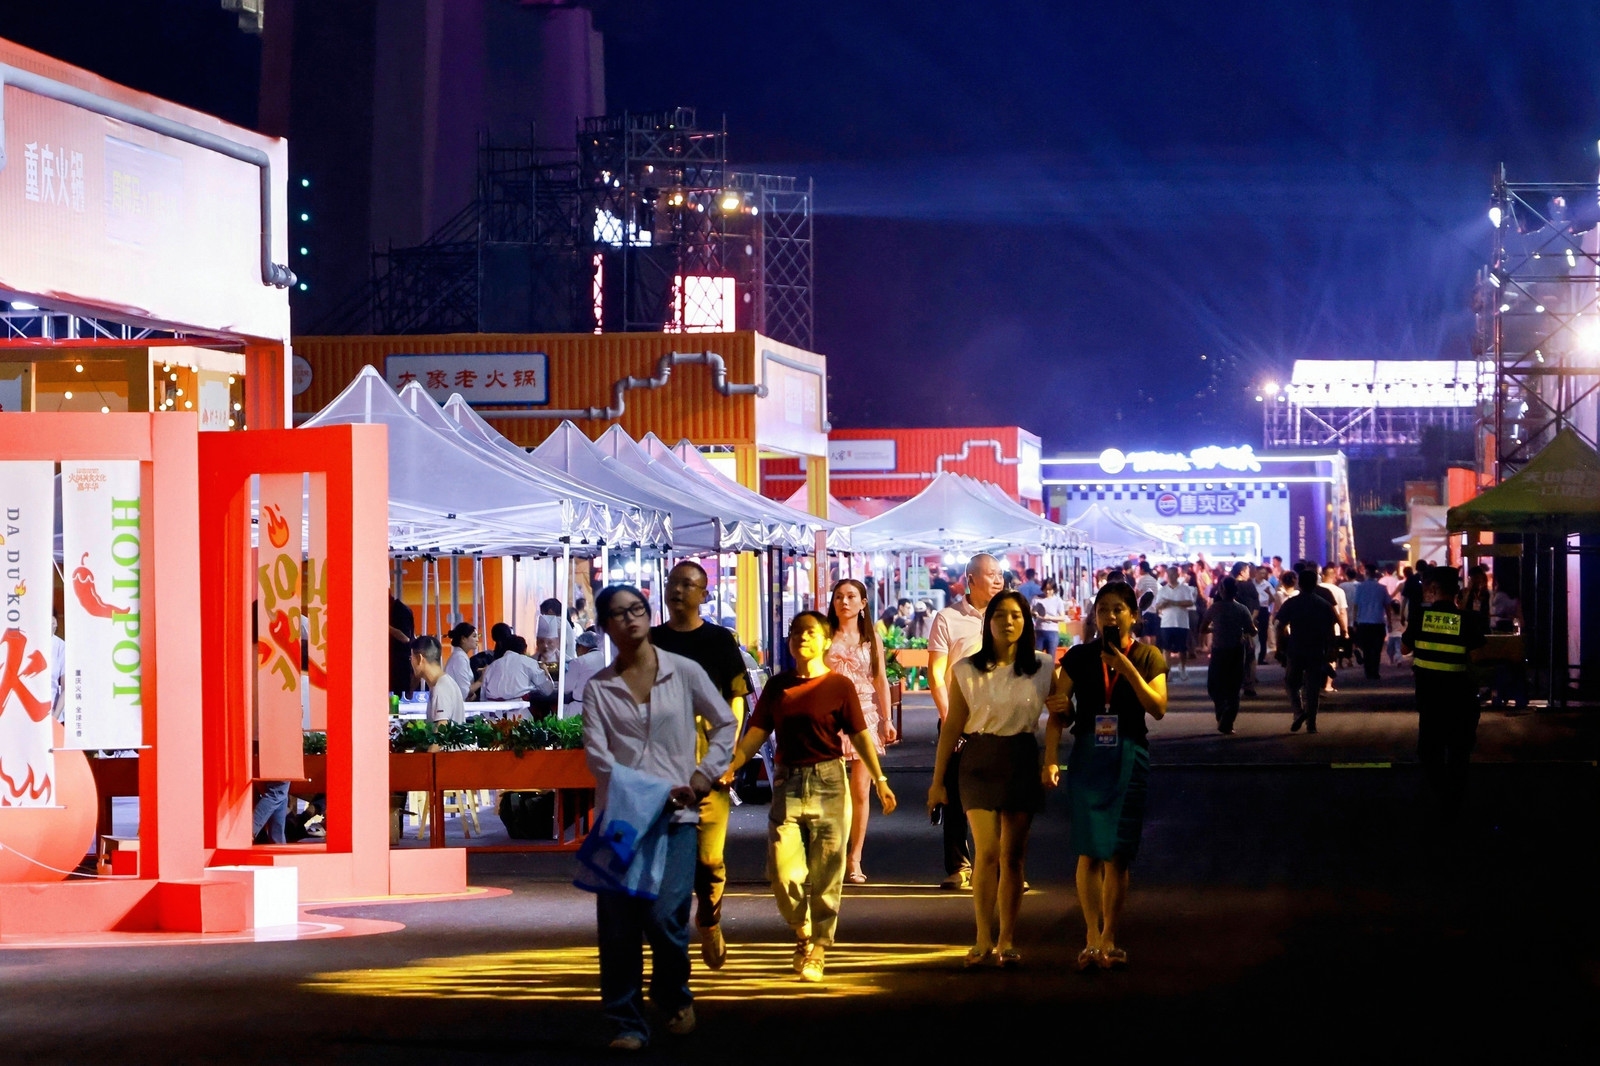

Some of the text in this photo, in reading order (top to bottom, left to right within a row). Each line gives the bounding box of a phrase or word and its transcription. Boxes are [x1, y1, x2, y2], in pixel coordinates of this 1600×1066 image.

[24, 141, 85, 212] 重庆火锅
[396, 369, 536, 390] 大象老火锅
[1178, 494, 1237, 514] 售卖区
